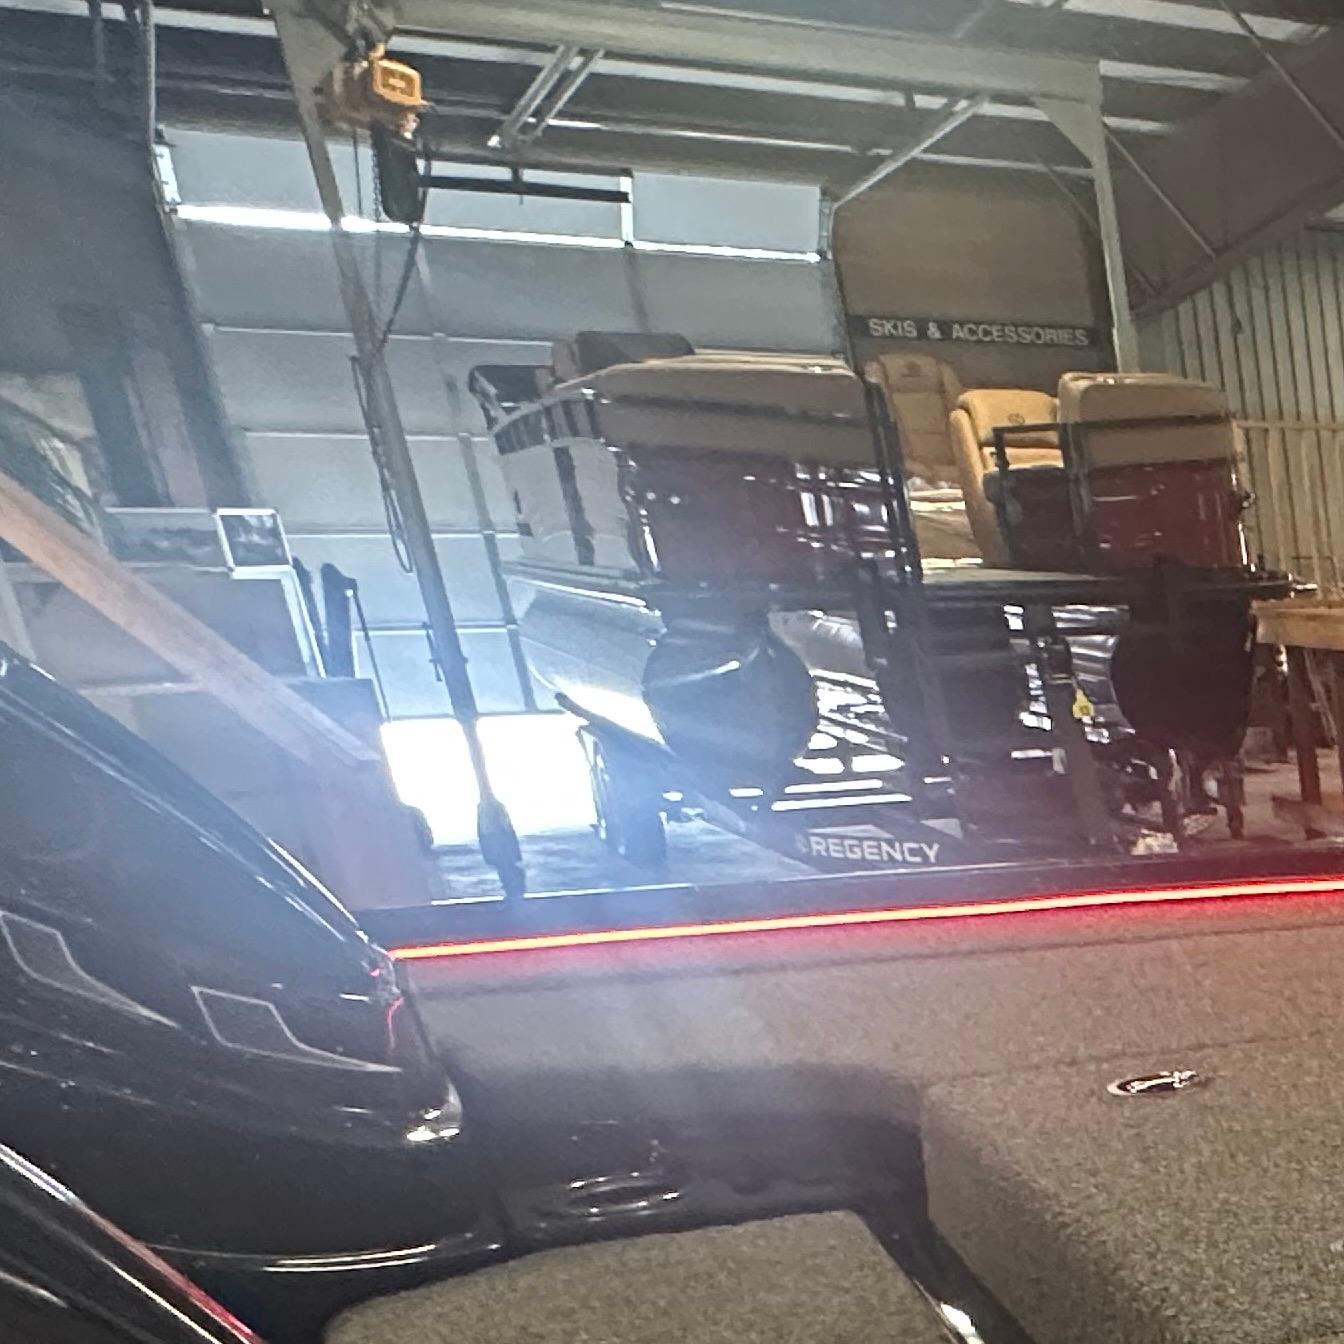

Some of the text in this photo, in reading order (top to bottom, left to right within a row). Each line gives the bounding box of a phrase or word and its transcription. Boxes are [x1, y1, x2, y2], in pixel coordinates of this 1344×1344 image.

[868, 318, 1089, 346] SKIS & ACCESSORIES
[809, 835, 941, 864] REGENCY
